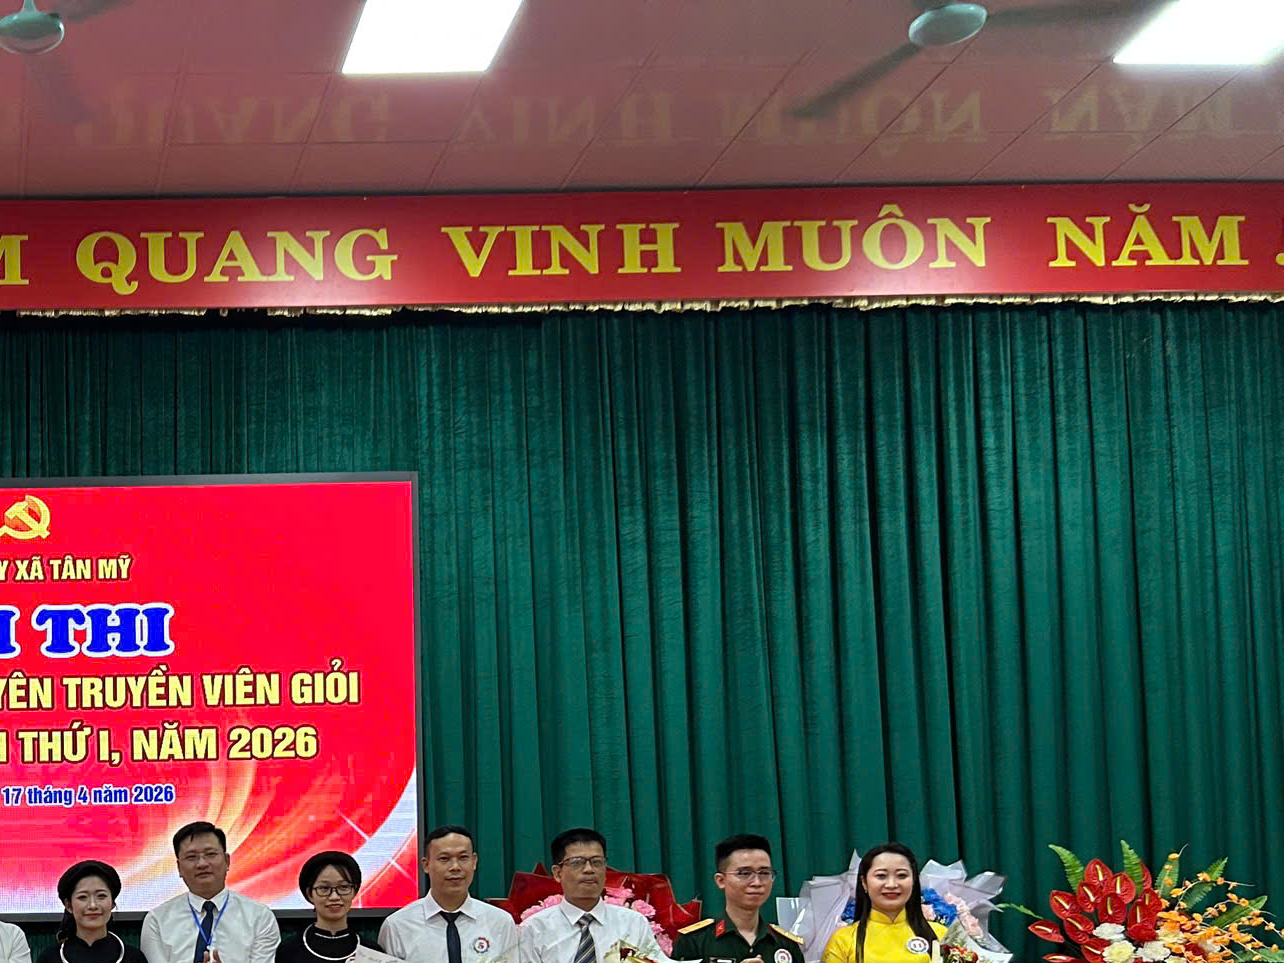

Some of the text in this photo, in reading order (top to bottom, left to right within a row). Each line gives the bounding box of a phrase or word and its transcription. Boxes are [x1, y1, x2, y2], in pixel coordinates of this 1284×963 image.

[76, 228, 398, 295] QUANG
[441, 223, 682, 278] VINH
[716, 204, 992, 273] MUÔN
[1046, 202, 1250, 267] NĂM
[15, 556, 44, 581] XÃ
[50, 555, 91, 580] TÂN
[98, 555, 132, 579] MỸ
[34, 606, 173, 655] THI
[62, 665, 192, 708] TRUYỀN
[202, 667, 280, 706] VIÊN
[291, 659, 359, 704] GIỎI
[18, 722, 92, 762] THỨ
[99, 730, 121, 765] I,
[132, 722, 218, 761] NĂM
[228, 726, 318, 760] 2026
[2, 787, 22, 805] 17
[27, 786, 72, 806] tháng
[78, 786, 88, 803] 4
[93, 785, 128, 803] năm
[133, 784, 174, 803] 2026
